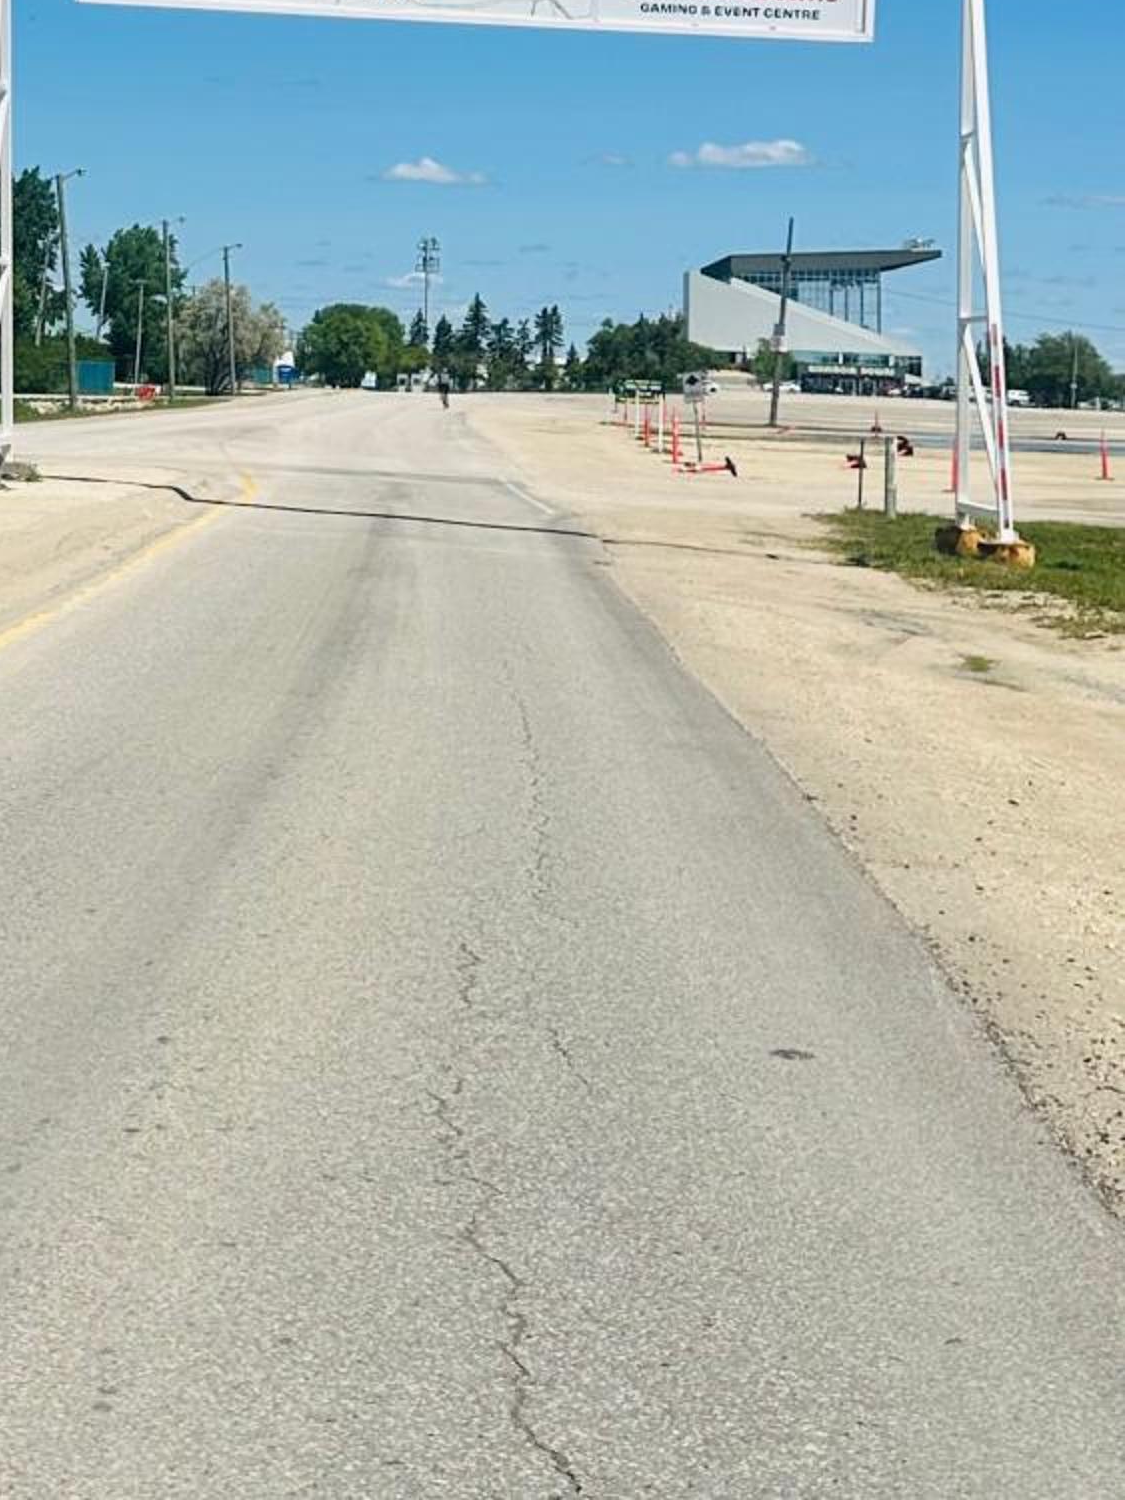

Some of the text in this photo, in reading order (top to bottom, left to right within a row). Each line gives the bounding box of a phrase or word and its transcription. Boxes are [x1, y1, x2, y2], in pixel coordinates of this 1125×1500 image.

[640, 2, 821, 21] GAMING & EVENT CENTRE
